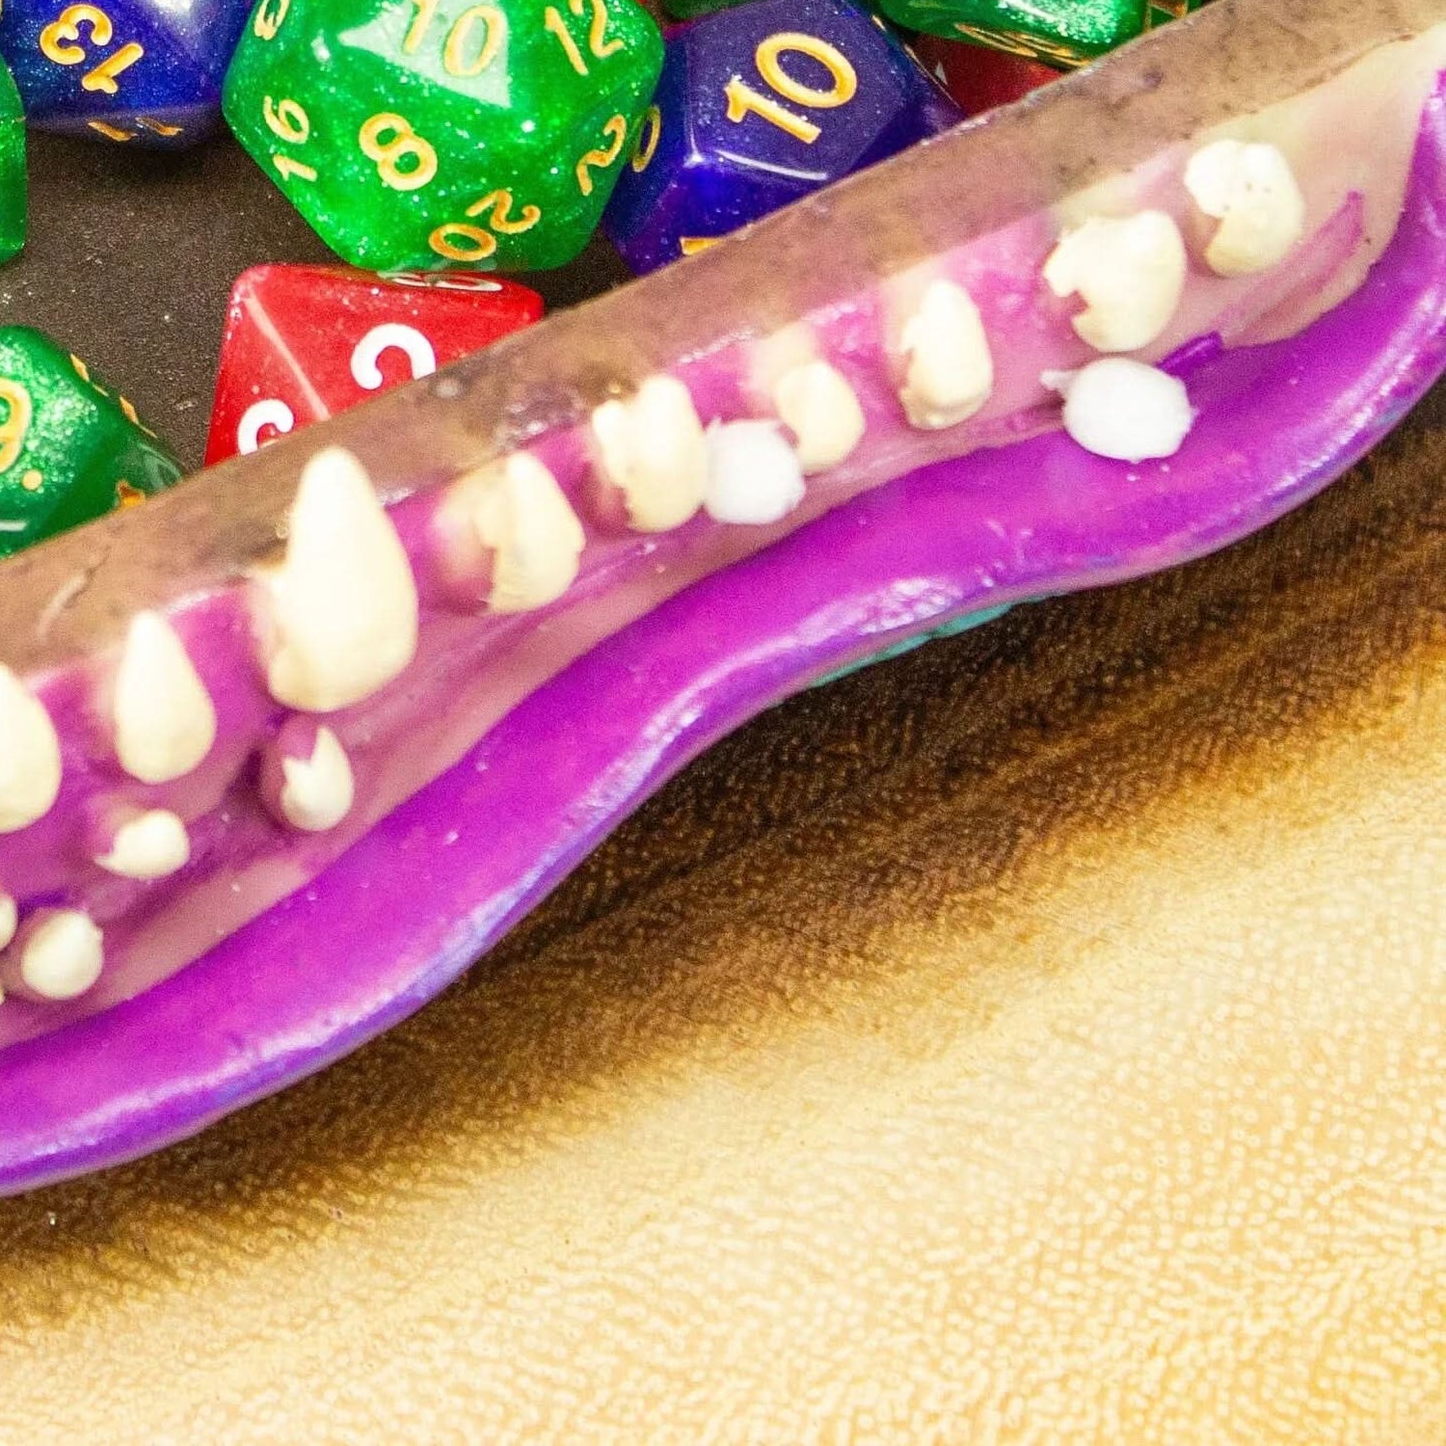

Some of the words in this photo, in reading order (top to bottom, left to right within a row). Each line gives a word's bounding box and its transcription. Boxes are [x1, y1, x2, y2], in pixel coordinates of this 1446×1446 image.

[39, 3, 144, 94] 13
[724, 32, 857, 145] 10
[263, 95, 318, 183] 16
[359, 112, 438, 191] 8
[576, 114, 627, 196] 2
[428, 189, 541, 261] 20
